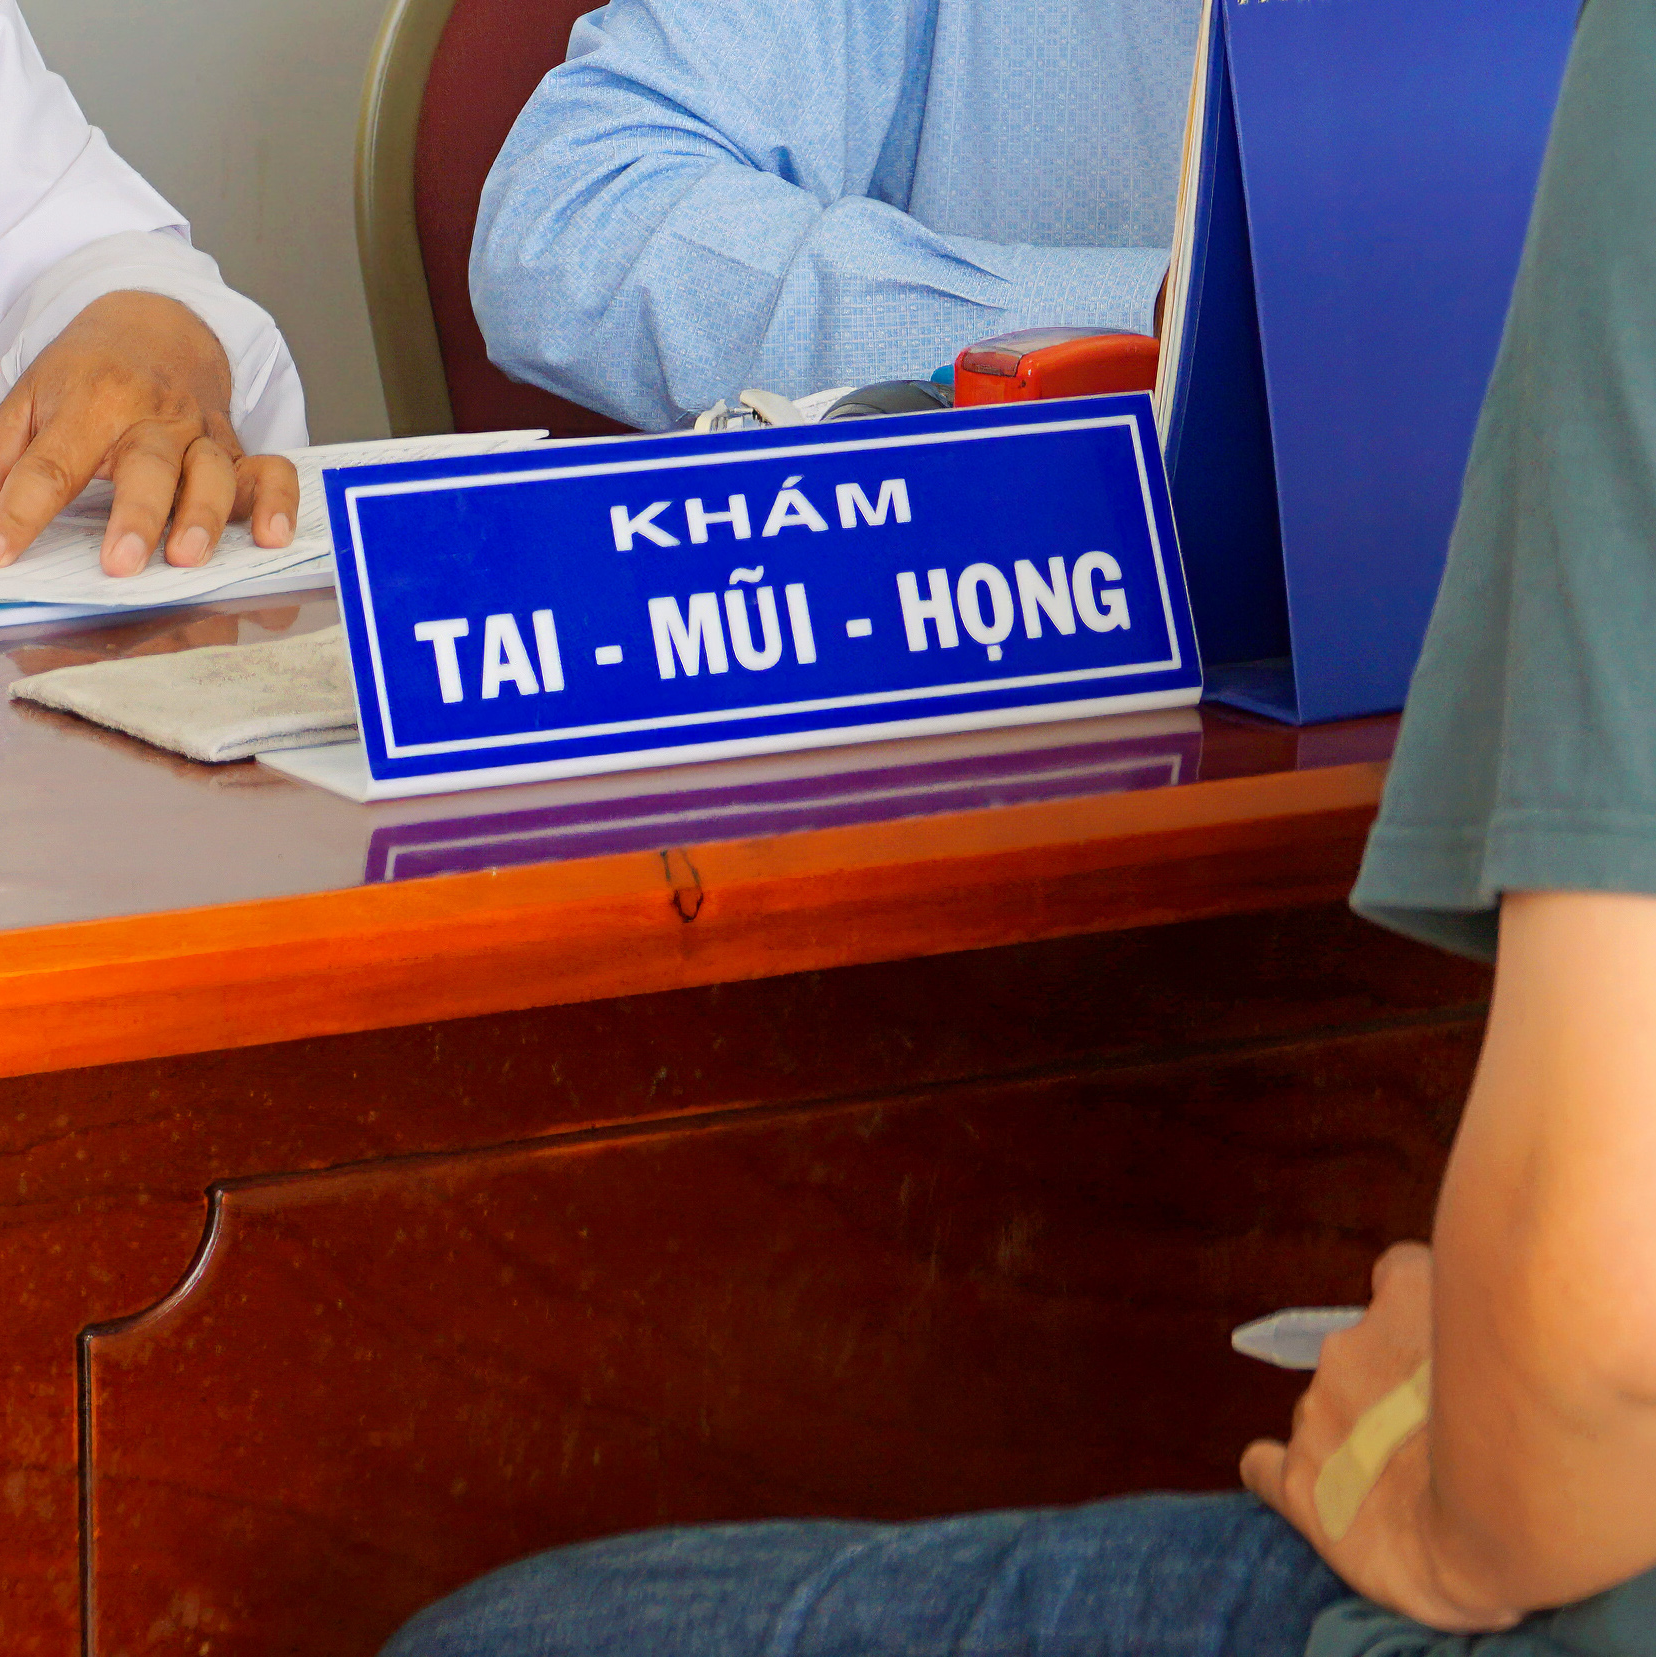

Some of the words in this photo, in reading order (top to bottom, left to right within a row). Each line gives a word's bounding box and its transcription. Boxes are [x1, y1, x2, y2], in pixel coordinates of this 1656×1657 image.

[610, 475, 913, 551] KHÁM
[414, 608, 564, 704] TAI
[648, 565, 817, 680] MŨI
[896, 550, 1132, 661] HỌNG
